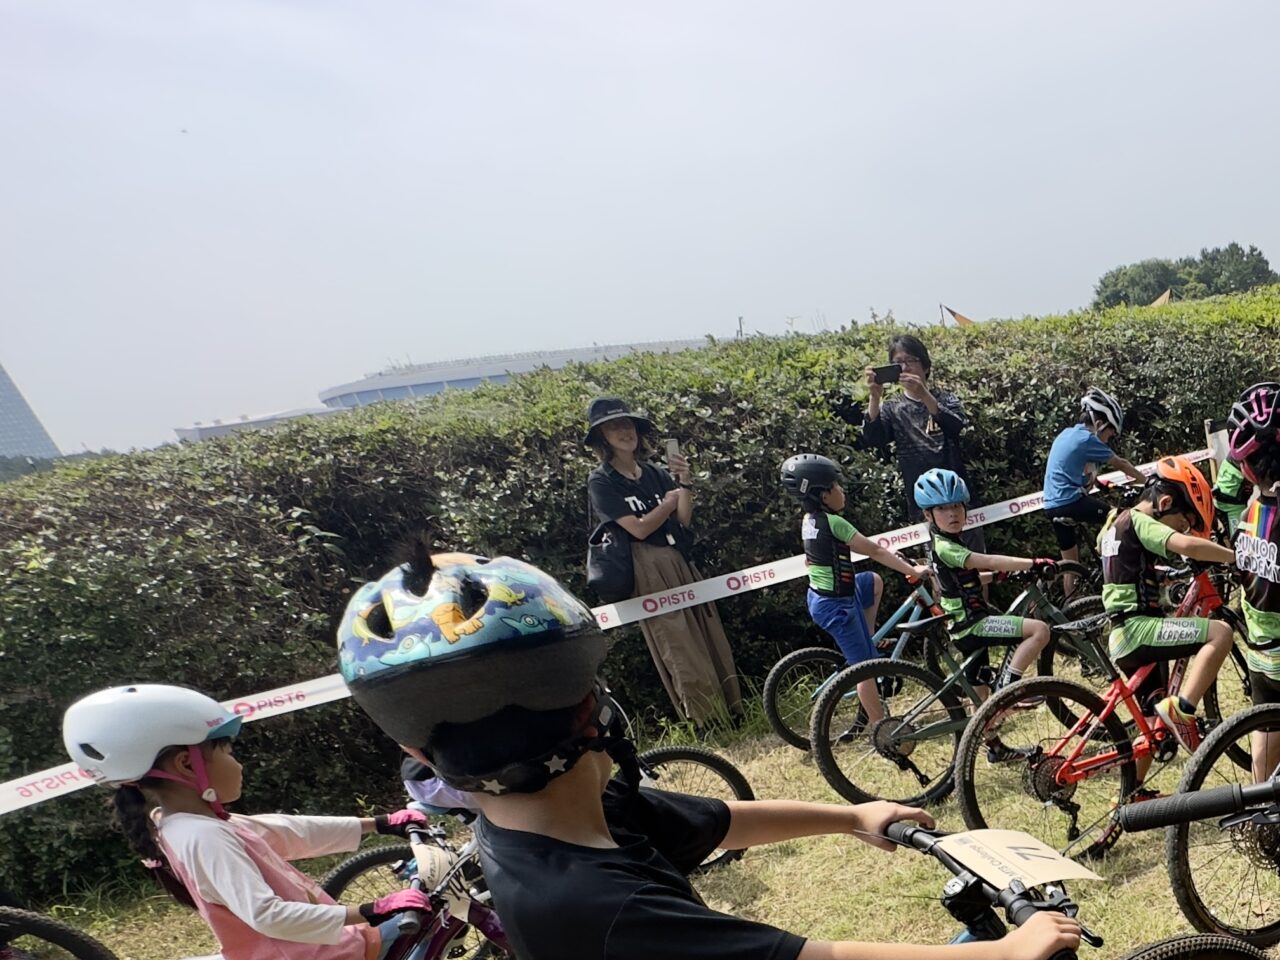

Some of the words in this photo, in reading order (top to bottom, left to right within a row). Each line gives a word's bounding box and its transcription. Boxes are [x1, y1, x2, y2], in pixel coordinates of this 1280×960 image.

[965, 512, 986, 525] ST6
[891, 530, 920, 545] PIST6
[1236, 534, 1278, 562] JUNIOR
[742, 569, 776, 587] PIST6
[659, 590, 696, 608] PIST6
[1157, 628, 1200, 641] ACADEMY
[256, 692, 306, 712] PIST6
